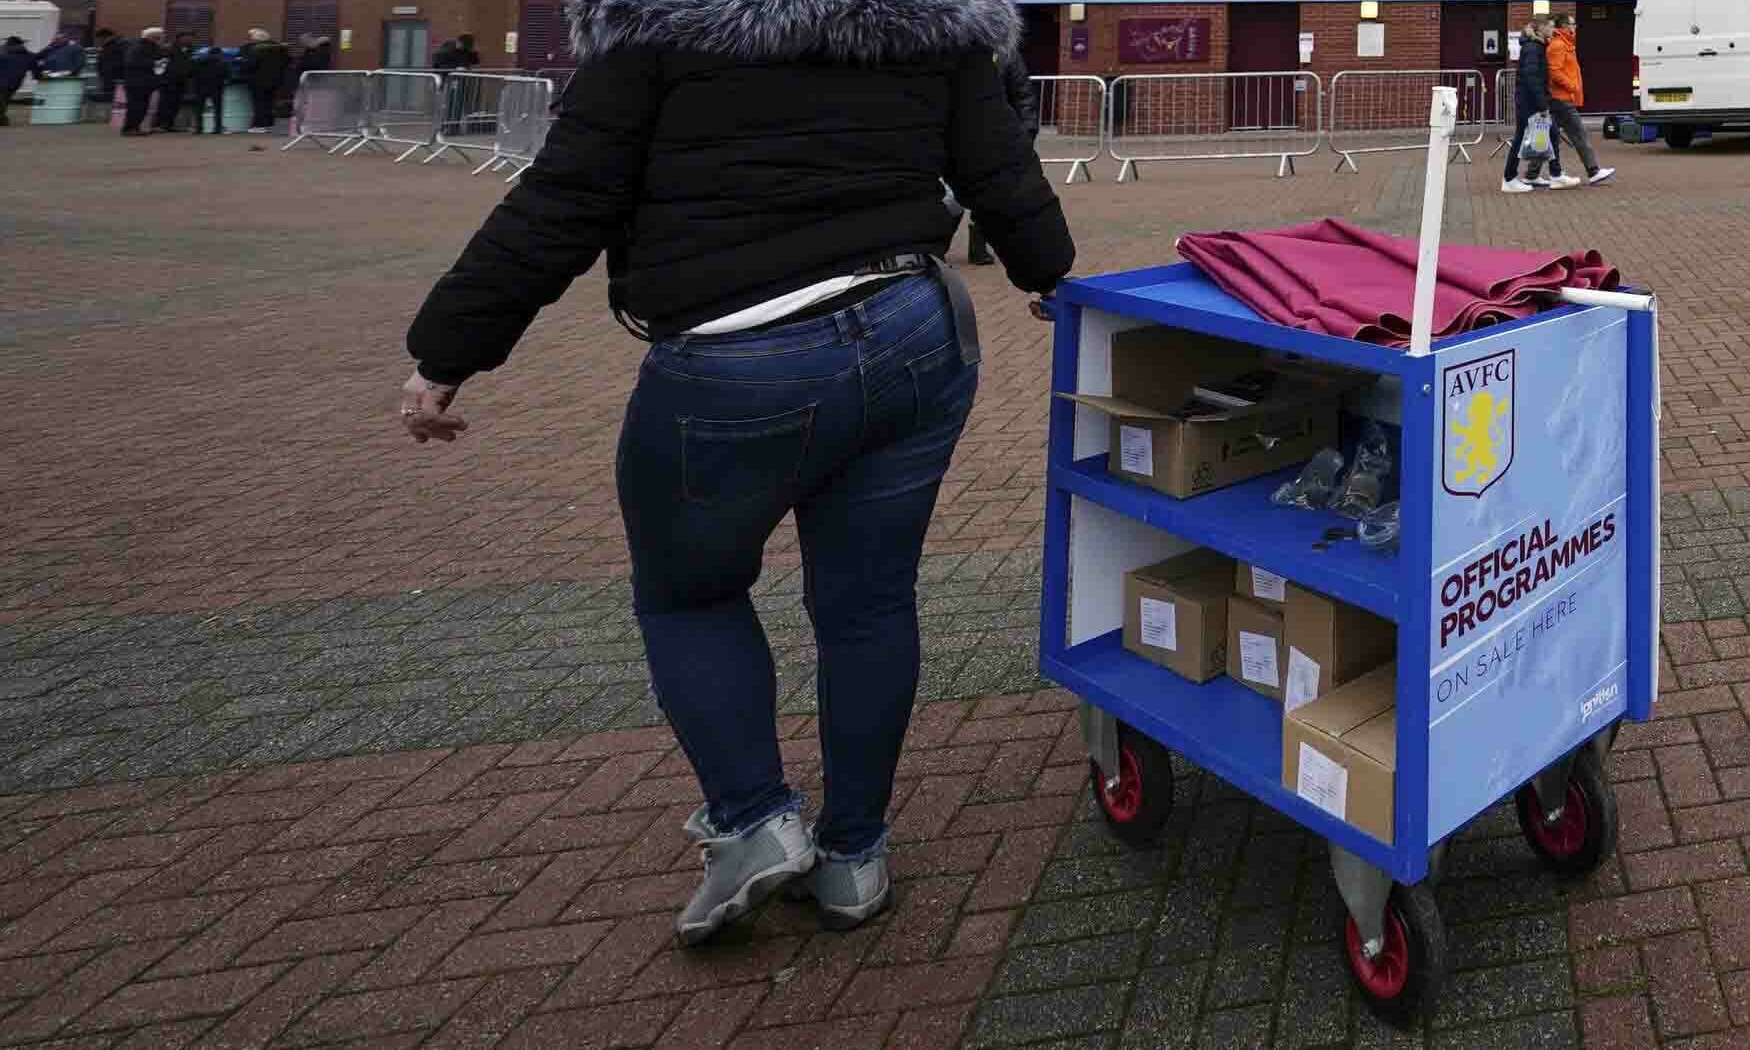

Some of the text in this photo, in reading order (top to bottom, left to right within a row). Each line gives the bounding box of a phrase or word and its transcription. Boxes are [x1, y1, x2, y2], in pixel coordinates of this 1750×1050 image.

[1450, 359, 1509, 398] AVFC
[1440, 513, 1616, 648] PROGRAMMES
[1441, 518, 1558, 607] OFFICIAL
[1437, 592, 1577, 703] ON SALE HERE
